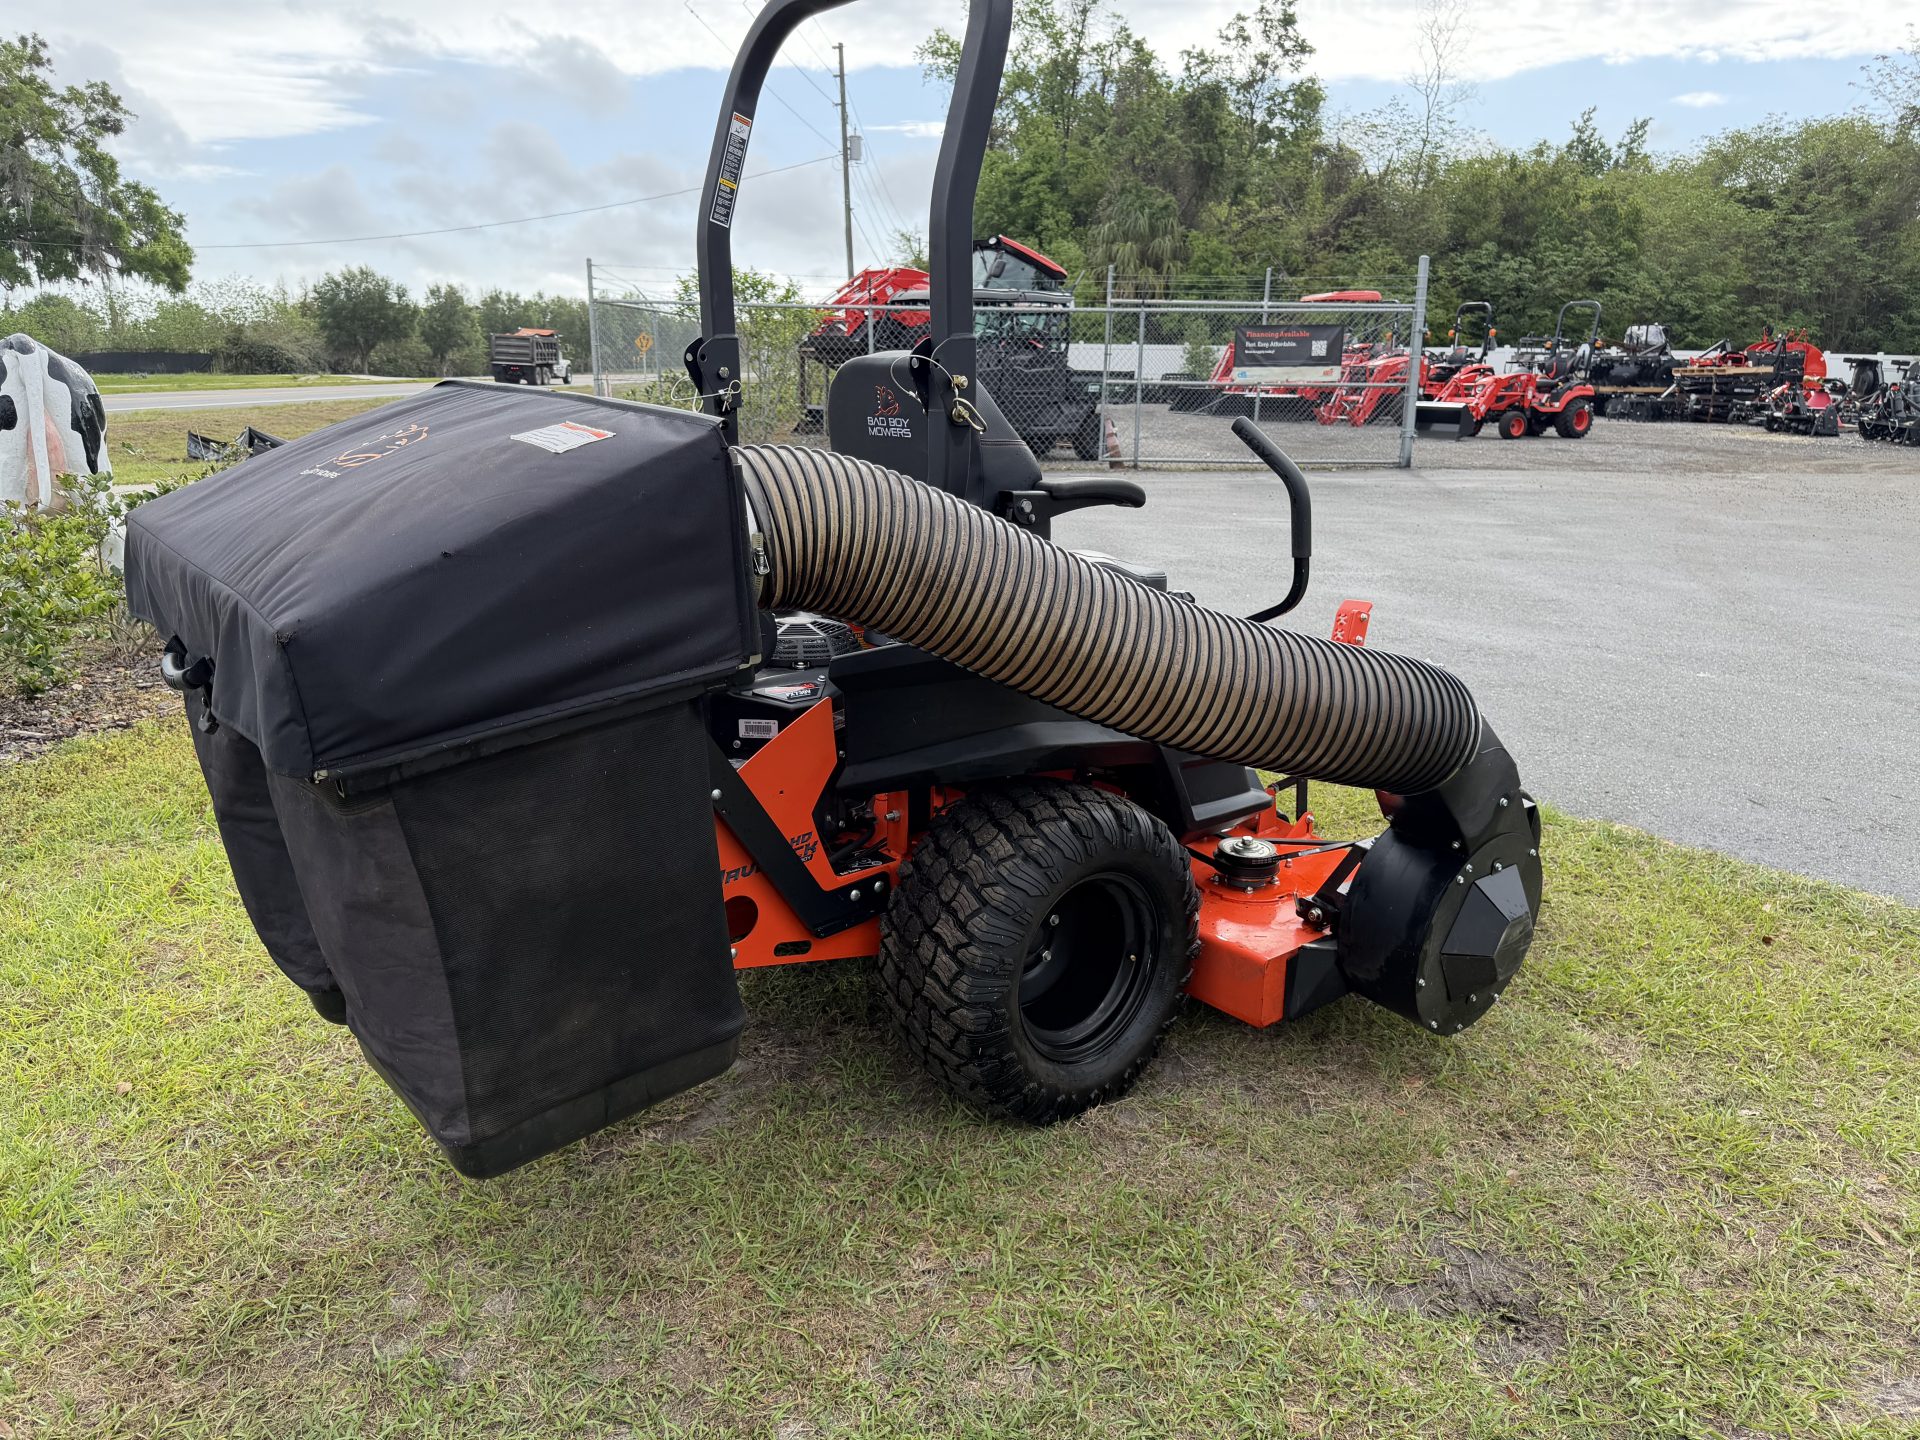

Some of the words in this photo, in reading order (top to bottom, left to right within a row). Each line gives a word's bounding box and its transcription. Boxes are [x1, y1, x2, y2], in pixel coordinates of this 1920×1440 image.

[1246, 331, 1279, 339] Financing
[1279, 330, 1310, 338] Available
[867, 416, 887, 426] BAD
[888, 417, 910, 428] BOY
[868, 427, 912, 438] MOWERS
[790, 831, 813, 846] HD
